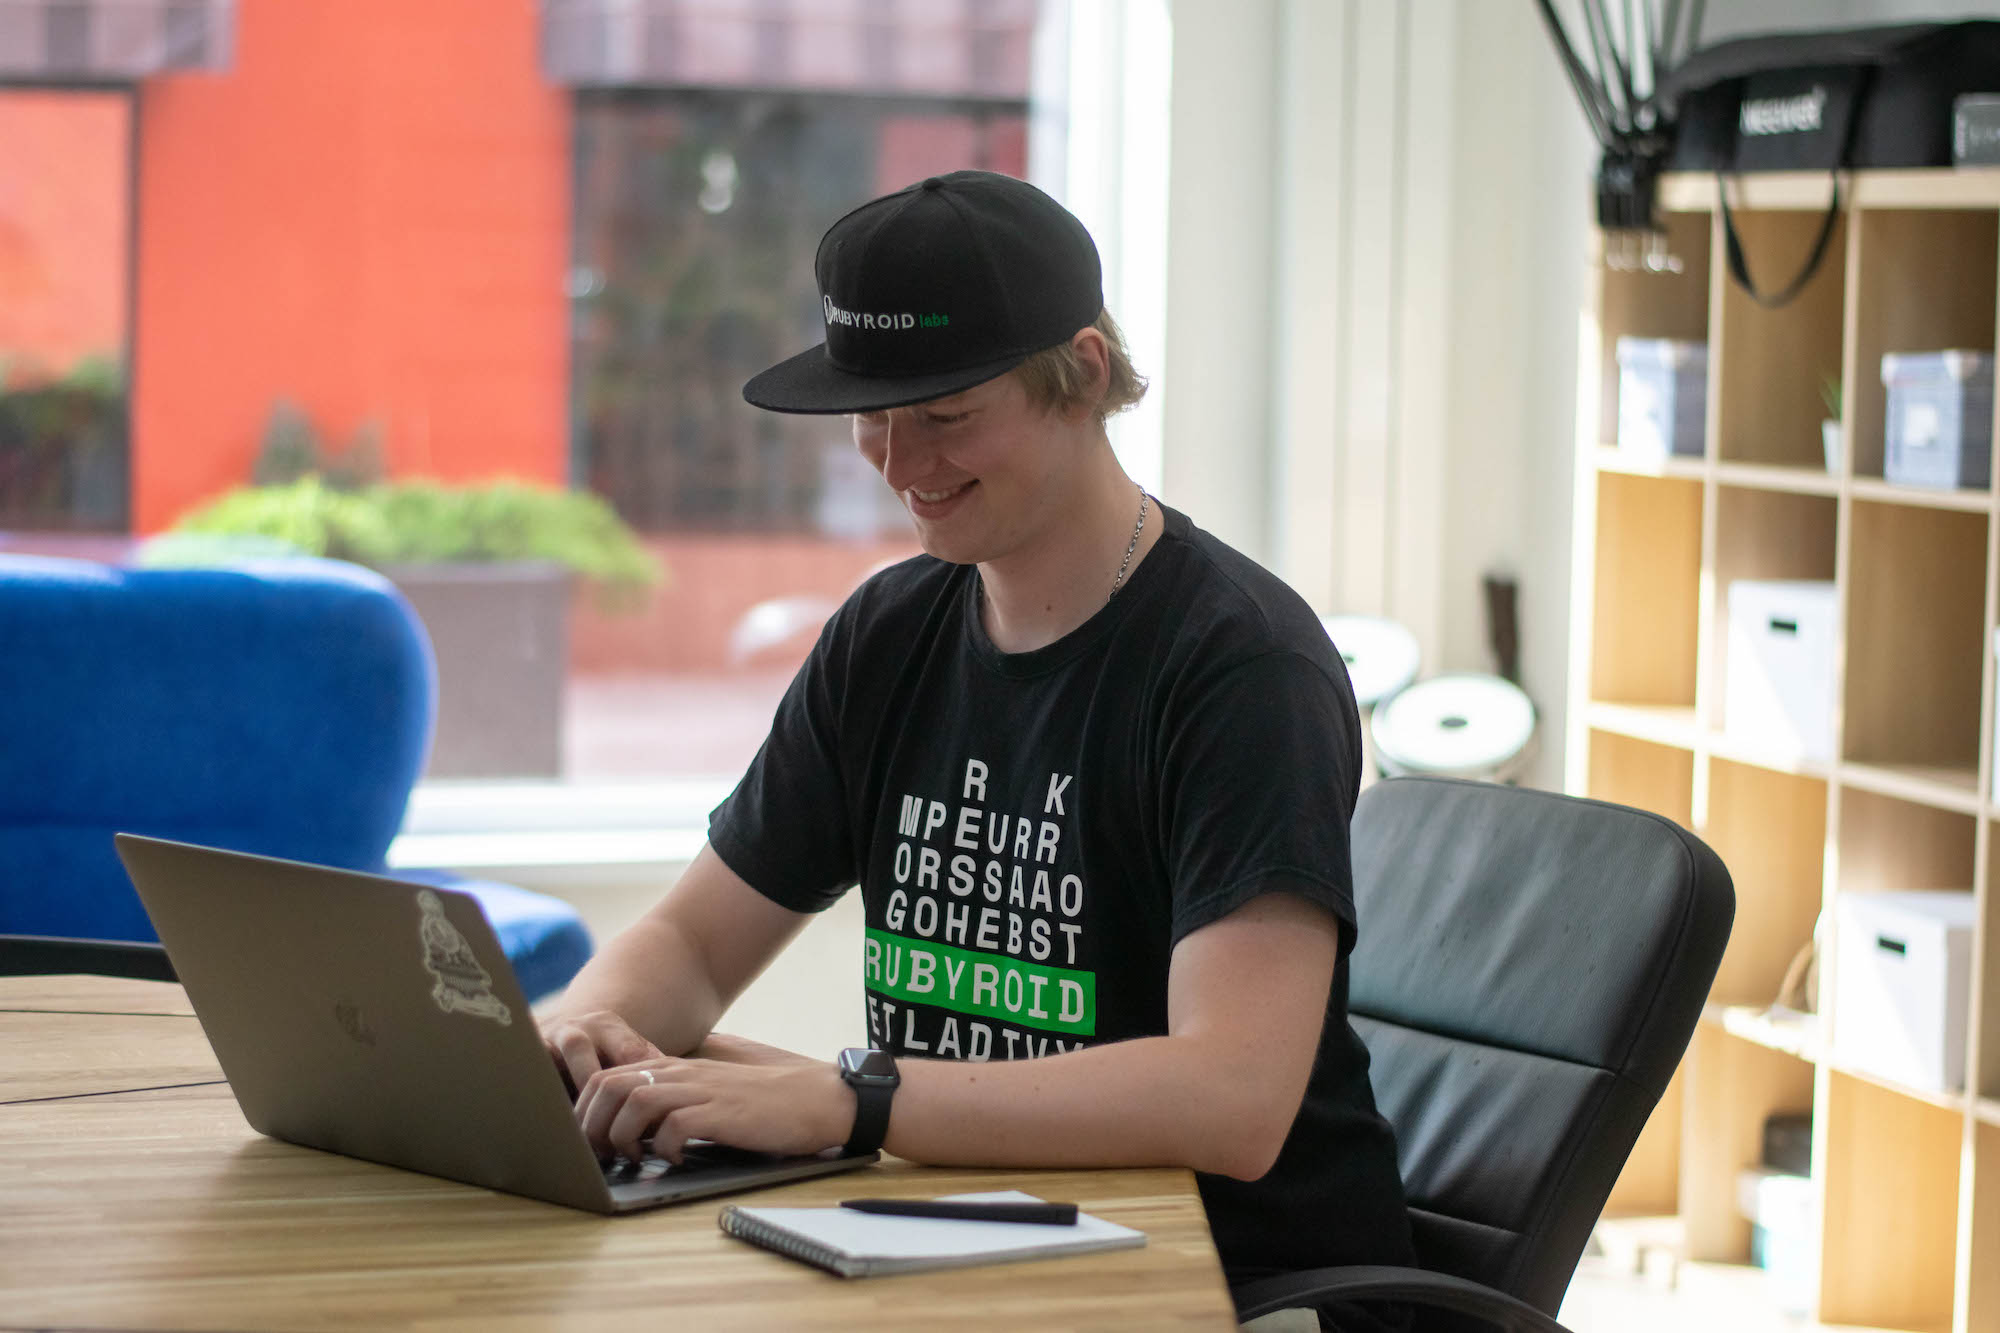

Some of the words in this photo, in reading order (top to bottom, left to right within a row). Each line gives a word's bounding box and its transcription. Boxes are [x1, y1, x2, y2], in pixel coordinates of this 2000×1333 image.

[831, 306, 915, 330] RUBYROID
[919, 313, 949, 329] labs
[962, 758, 989, 802] R
[1043, 772, 1073, 816] K
[866, 937, 1086, 1024] RUBYROID
